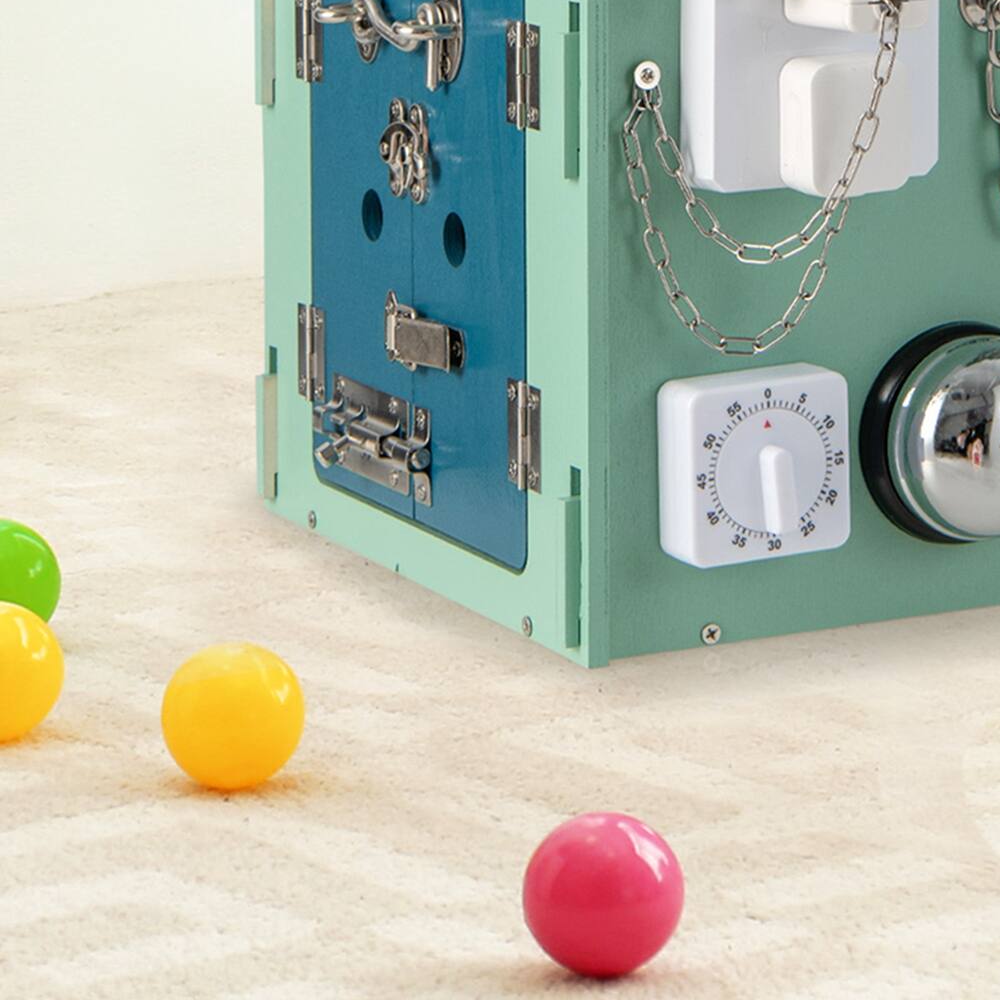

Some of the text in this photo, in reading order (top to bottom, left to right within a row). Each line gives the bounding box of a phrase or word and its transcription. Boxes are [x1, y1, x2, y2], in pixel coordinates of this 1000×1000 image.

[764, 388, 772, 399] 0
[798, 393, 808, 404] 5
[726, 401, 742, 418] 55
[822, 414, 836, 429] 10
[703, 433, 717, 450] 50
[834, 450, 845, 466] 15
[696, 473, 707, 490] 45
[825, 489, 839, 506] 20
[706, 510, 720, 526] 40
[800, 520, 816, 537] 25
[731, 534, 747, 548] 35
[767, 538, 782, 551] 30
